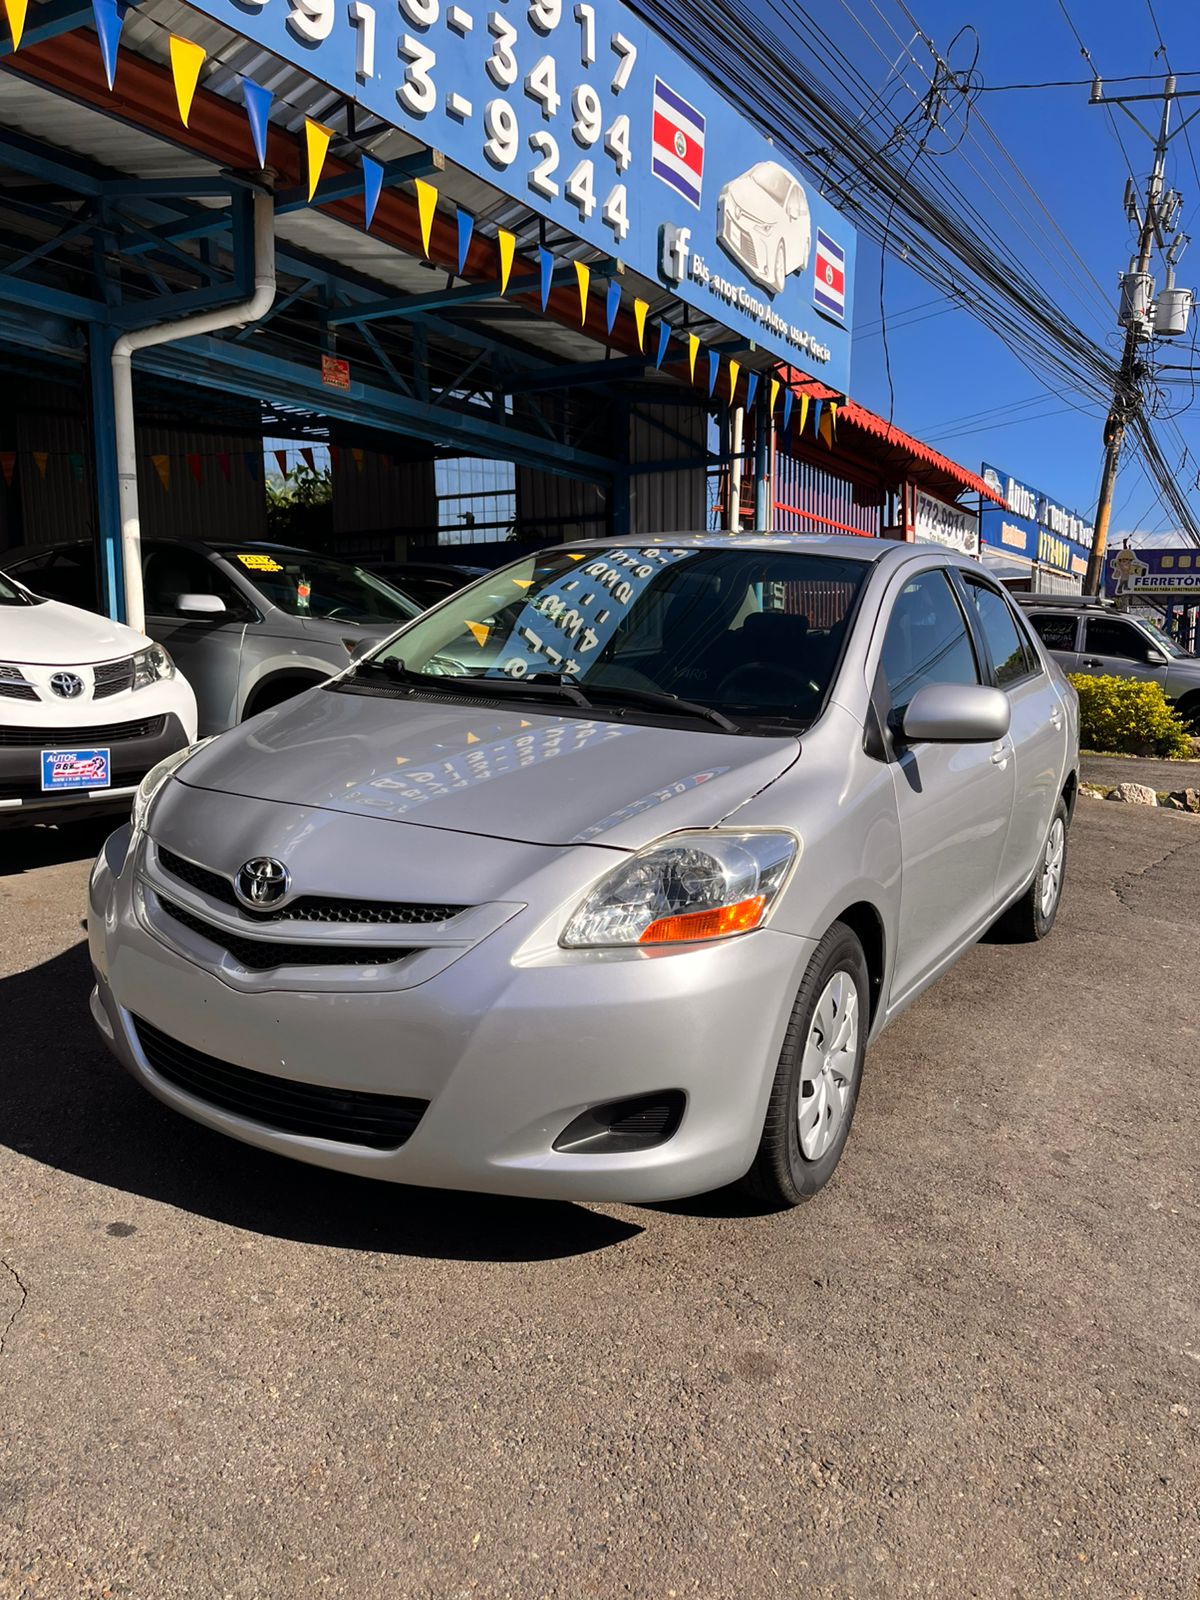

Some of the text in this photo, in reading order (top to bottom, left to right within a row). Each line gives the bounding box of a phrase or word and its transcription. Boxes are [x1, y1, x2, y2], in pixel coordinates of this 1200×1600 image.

[233, 0, 629, 240] 913-9244
[738, 286, 764, 318] Como
[765, 304, 788, 336] Autos
[810, 336, 831, 361] Grecia
[46, 753, 77, 763] AUTOS
